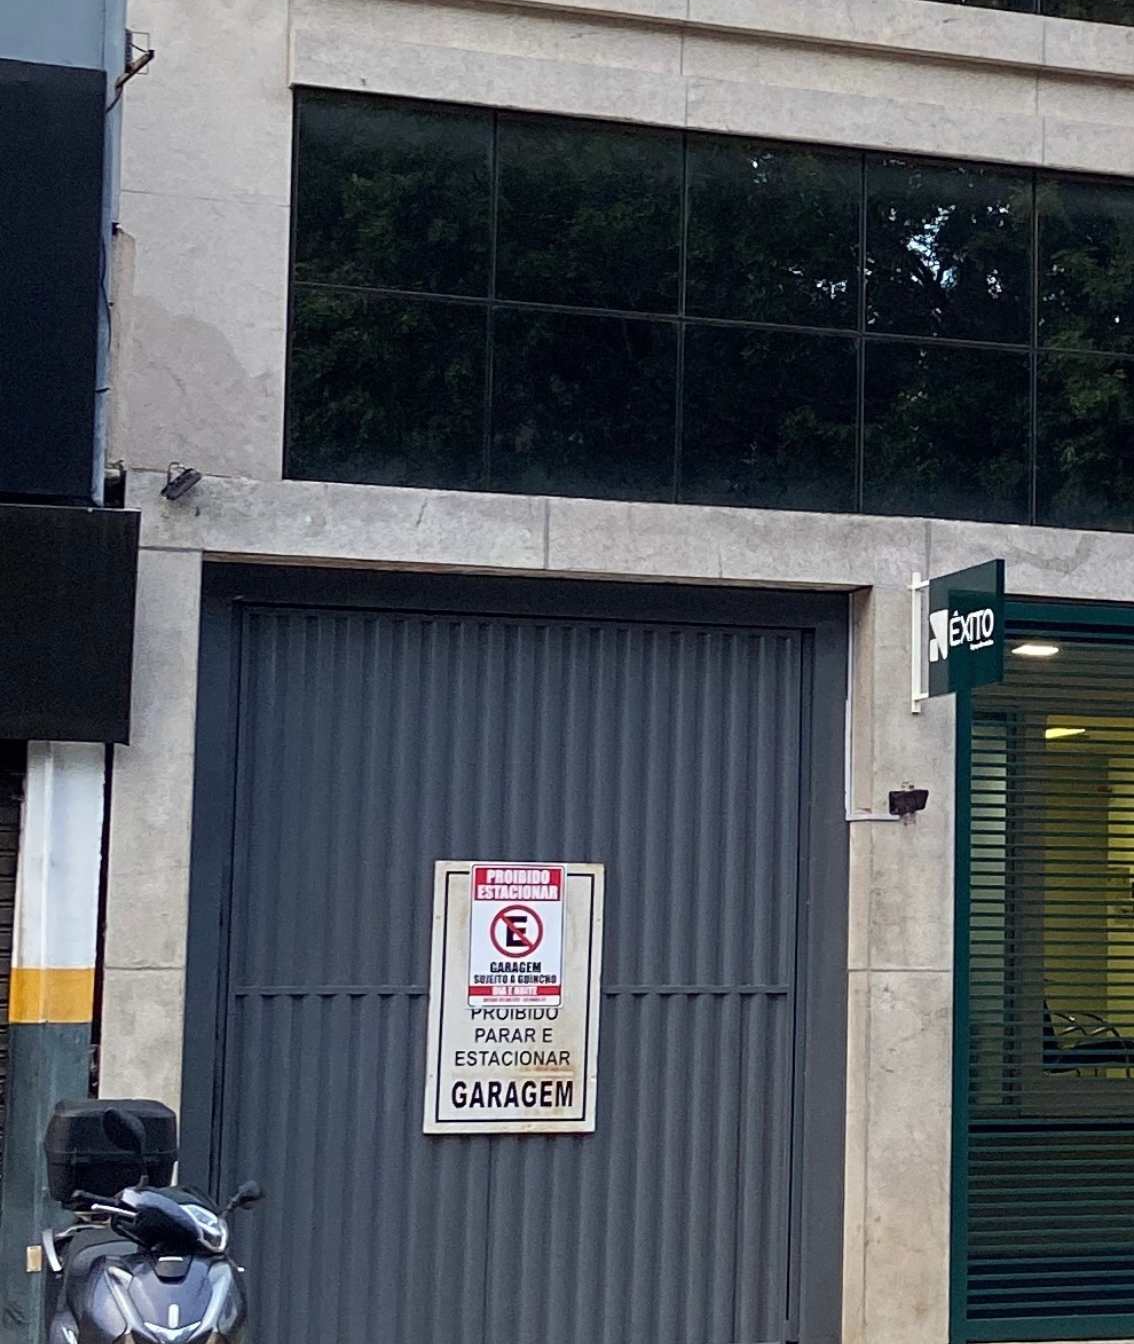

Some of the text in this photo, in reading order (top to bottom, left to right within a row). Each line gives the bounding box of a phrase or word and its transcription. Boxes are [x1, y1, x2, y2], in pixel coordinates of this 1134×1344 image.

[486, 869, 551, 884] PROIBIDO
[476, 884, 559, 900] ESTACIONAR
[506, 916, 529, 947] E
[490, 961, 542, 973] GARAGEM
[471, 1008, 559, 1020] PROIBIDO
[474, 1027, 553, 1043] PARAR E
[454, 1050, 571, 1067] ESTACIONAR
[451, 1080, 574, 1107] GARAGEM
